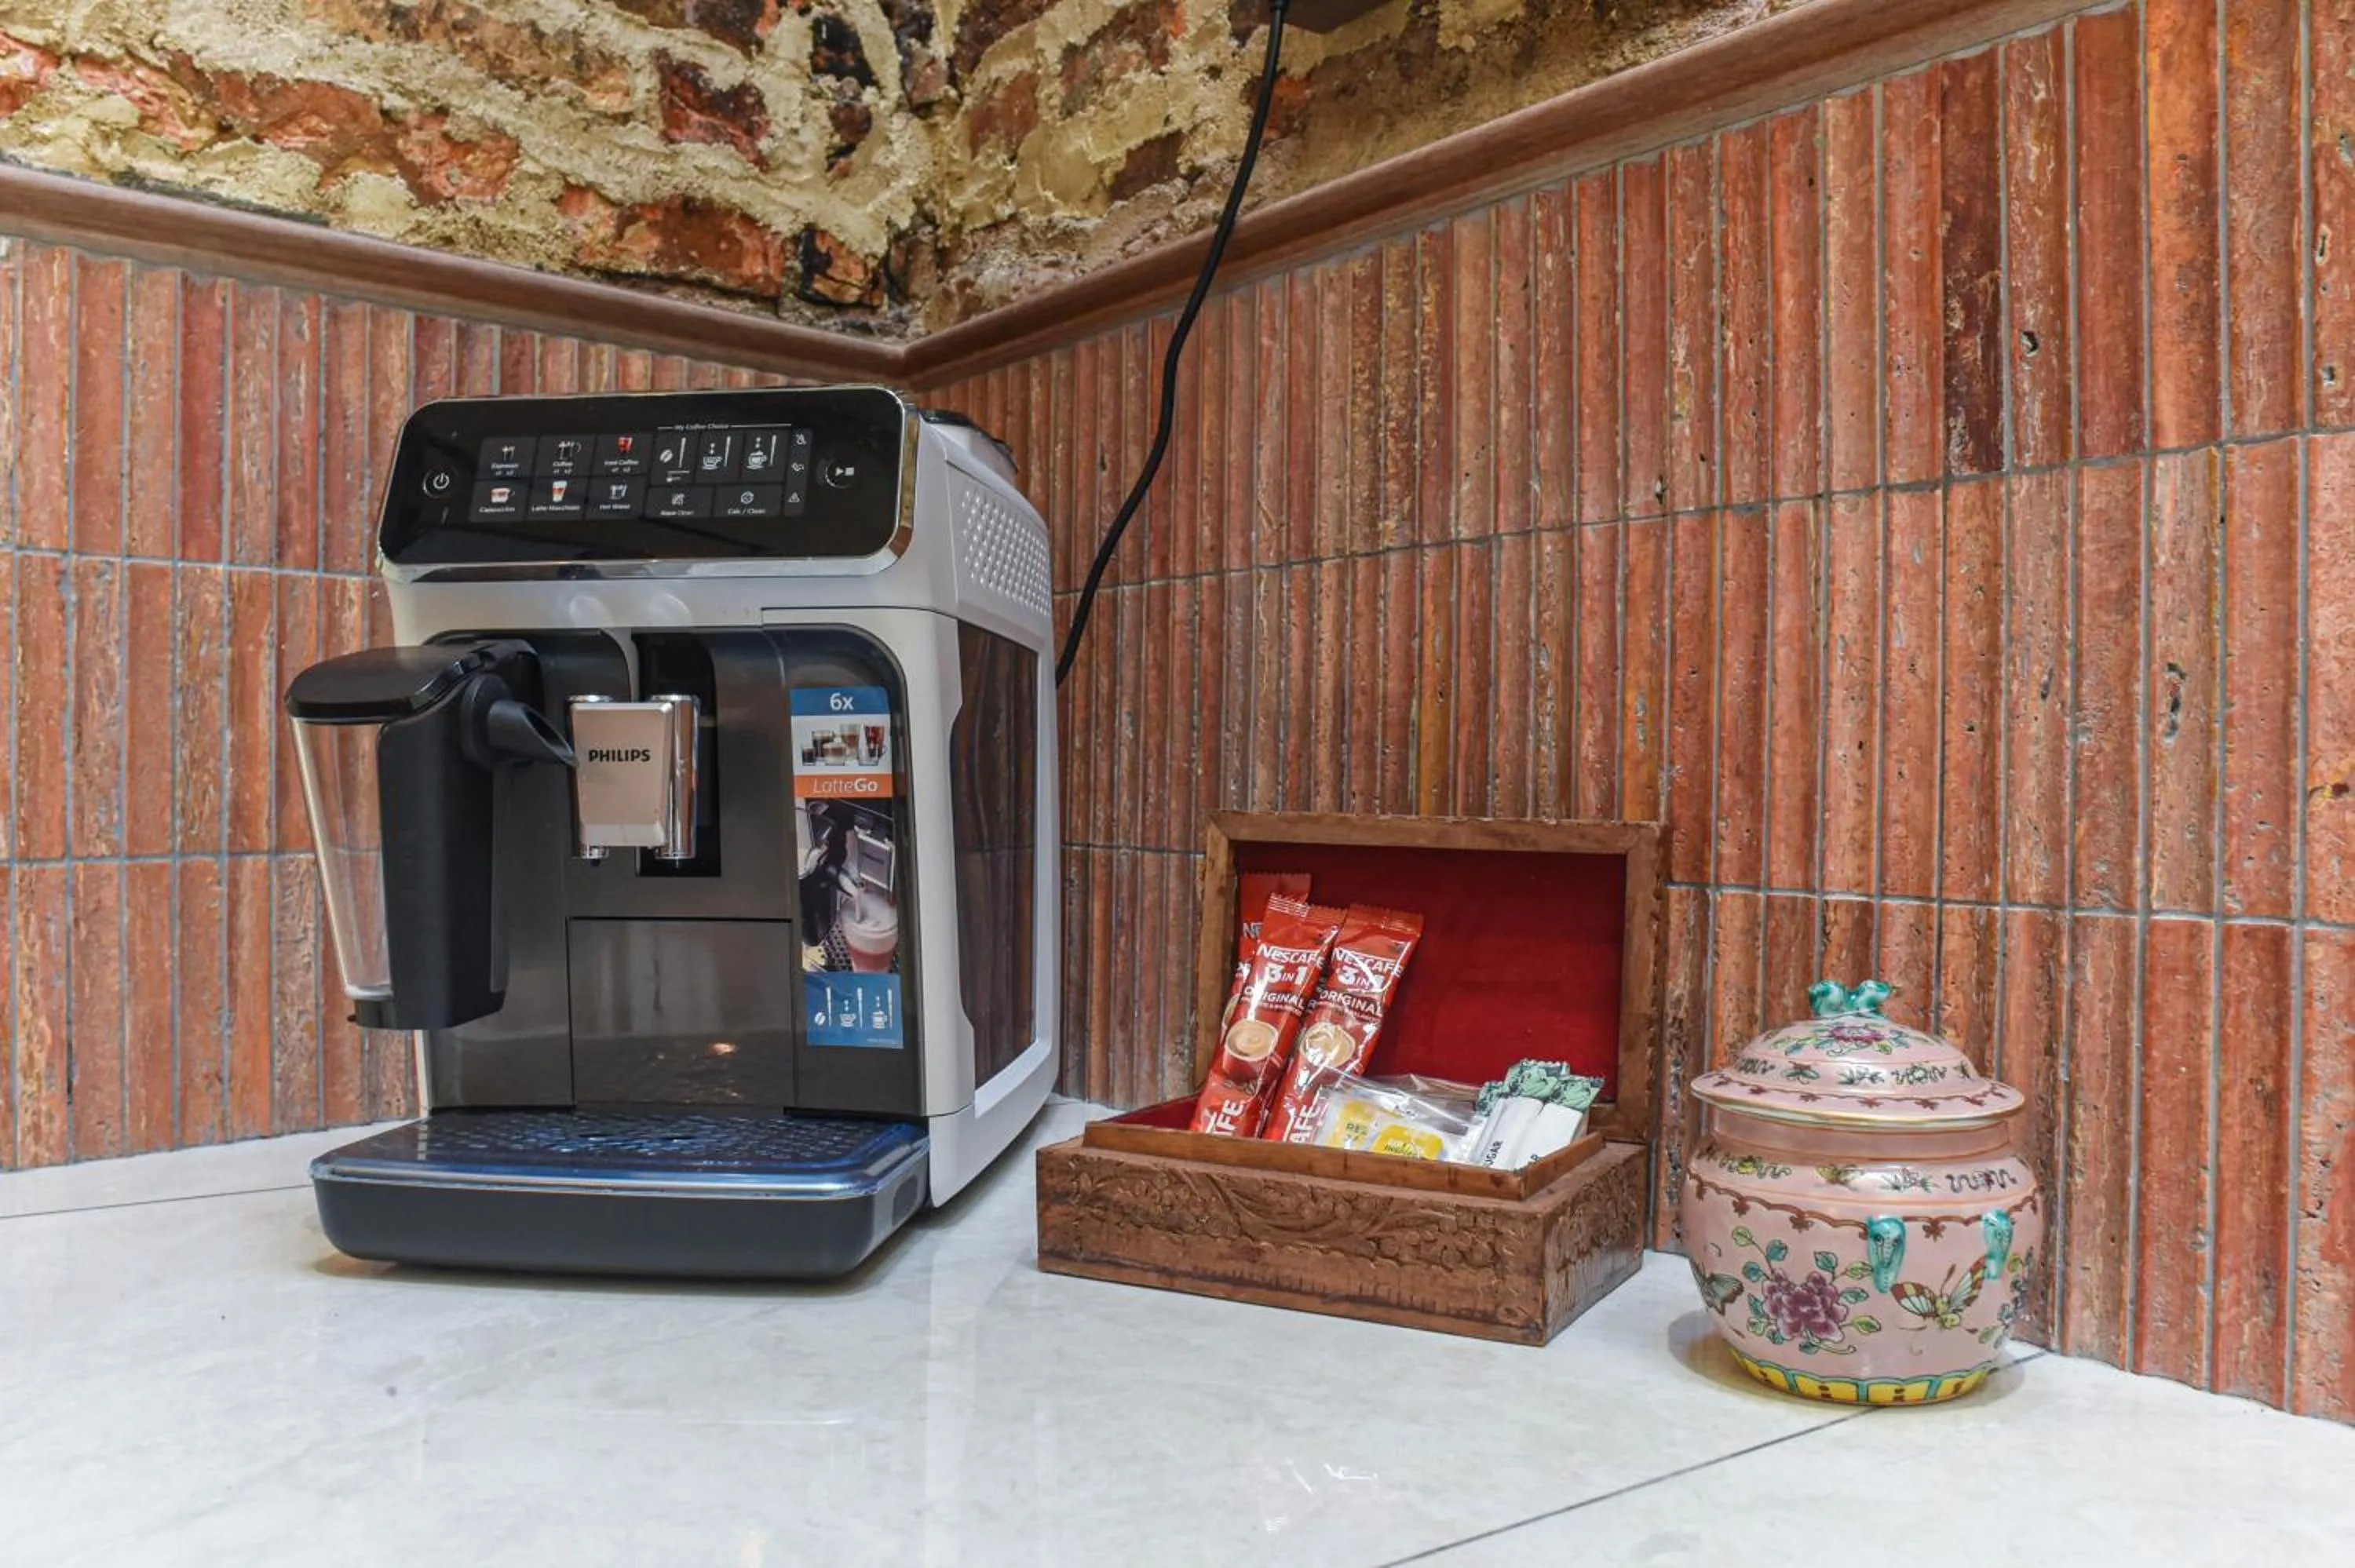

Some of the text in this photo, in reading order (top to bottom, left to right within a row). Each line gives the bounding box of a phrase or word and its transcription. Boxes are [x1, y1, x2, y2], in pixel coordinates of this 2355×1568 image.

[830, 692, 853, 710] 6x
[590, 749, 650, 762] PHILIPS
[812, 778, 878, 793] LatteGo
[1243, 986, 1305, 1010] OIGINAL
[1320, 990, 1383, 1018] ORIGINAL
